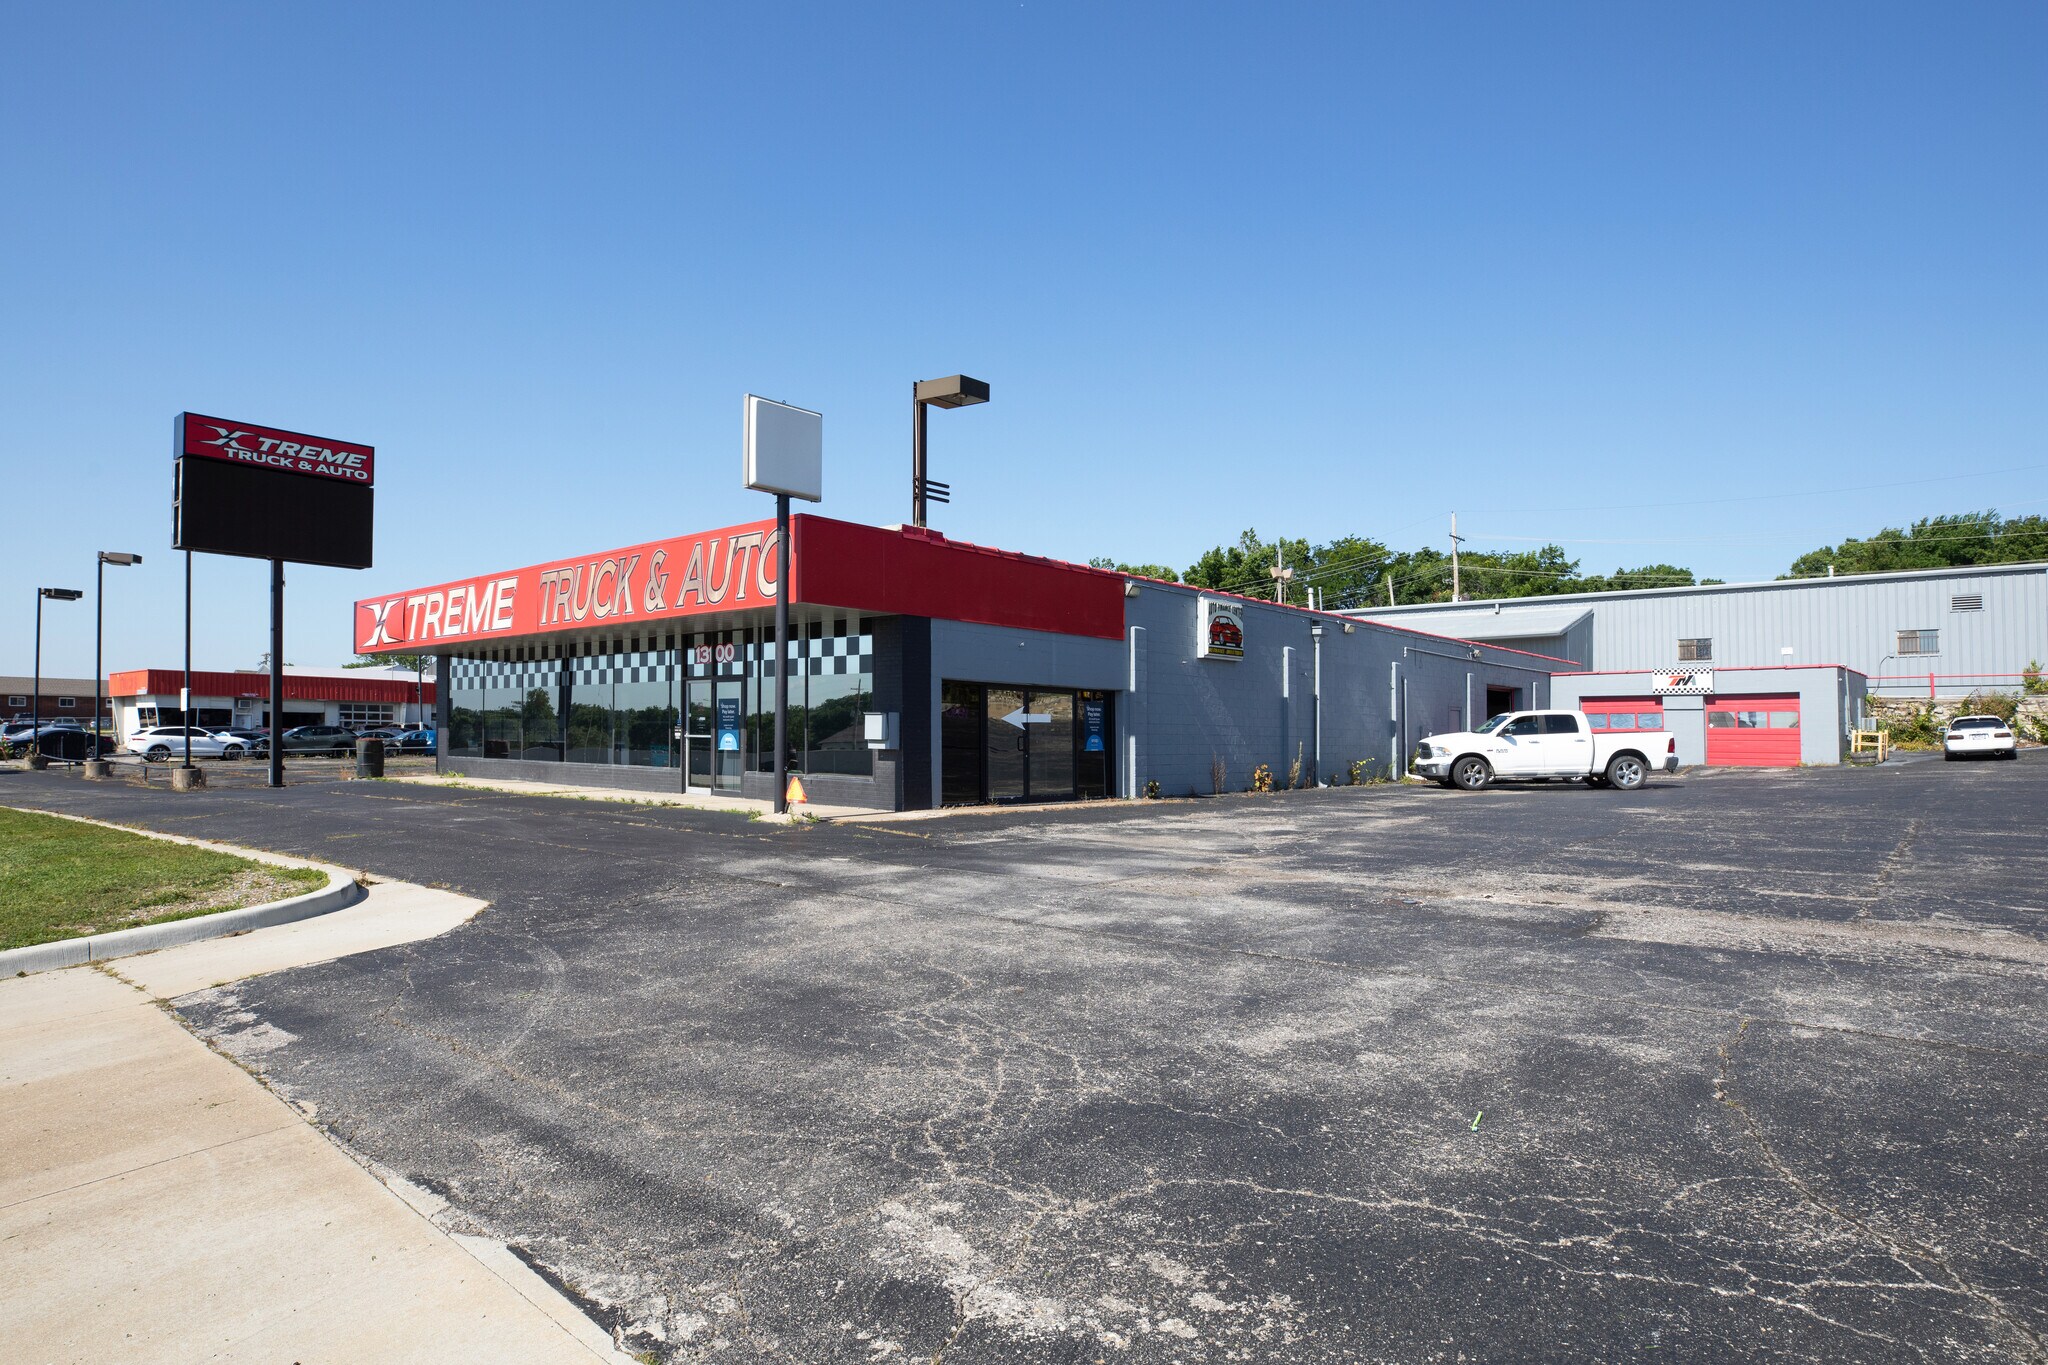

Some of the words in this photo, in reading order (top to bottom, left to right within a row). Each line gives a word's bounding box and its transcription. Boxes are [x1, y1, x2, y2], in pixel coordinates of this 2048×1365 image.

[223, 447, 294, 469] TRUCK
[298, 460, 312, 471] &
[315, 467, 368, 481] AUTO
[539, 553, 641, 626] TRUCK
[644, 549, 670, 613] &
